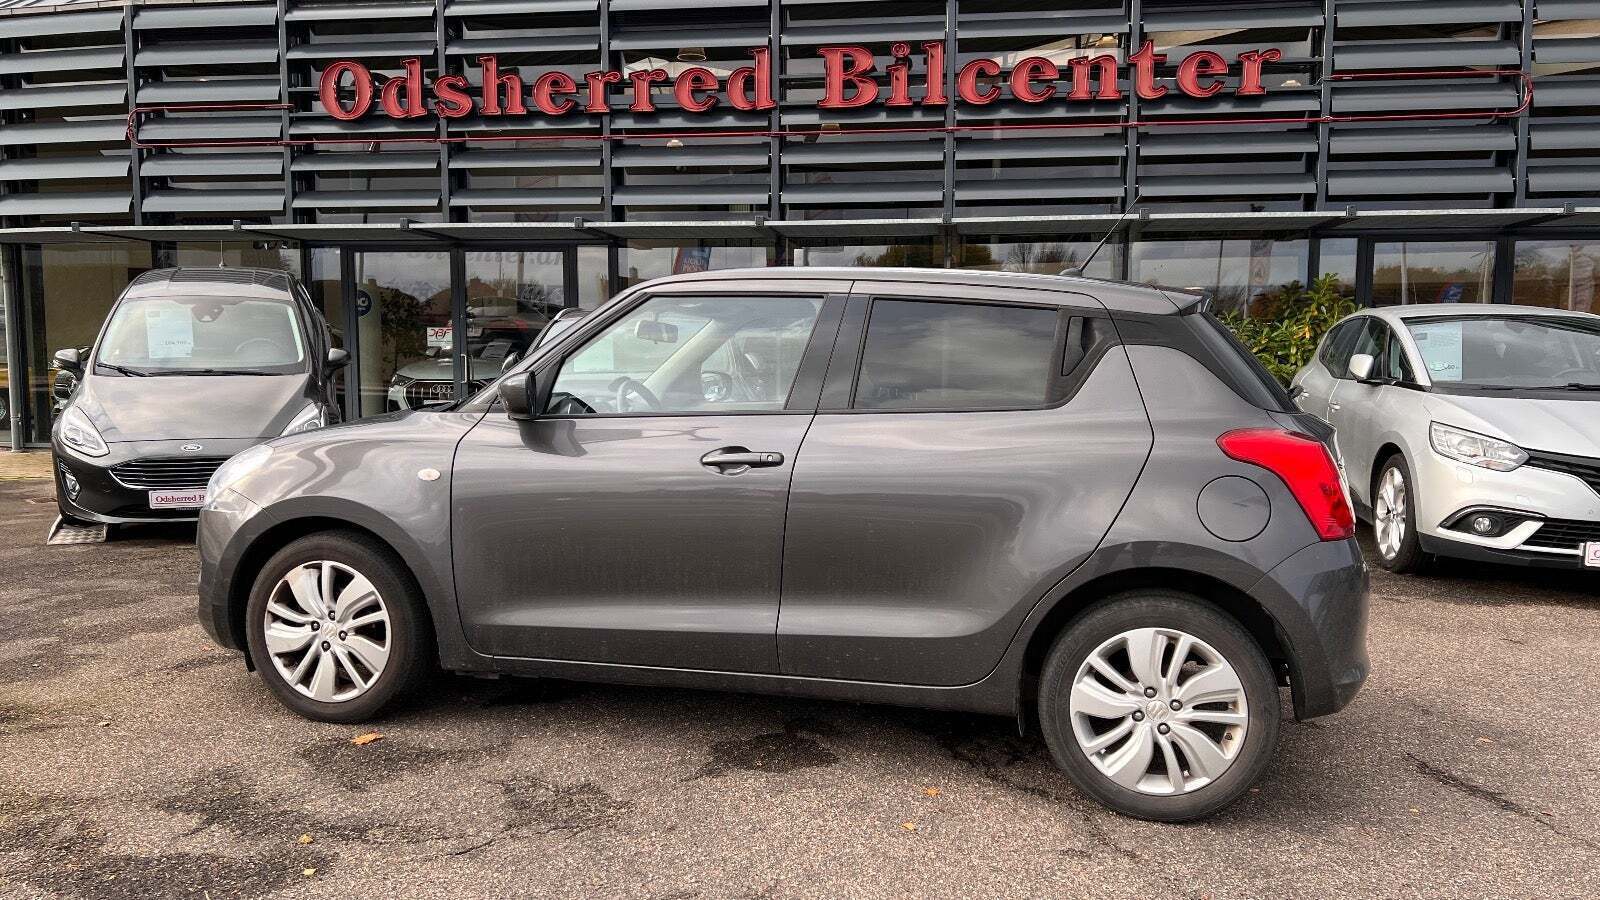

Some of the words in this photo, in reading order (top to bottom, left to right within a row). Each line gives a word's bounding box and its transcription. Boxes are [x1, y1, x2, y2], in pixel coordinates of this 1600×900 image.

[319, 47, 777, 121] Odsherred
[818, 39, 1282, 109] Bilcenter
[155, 495, 197, 503] Odsherred
